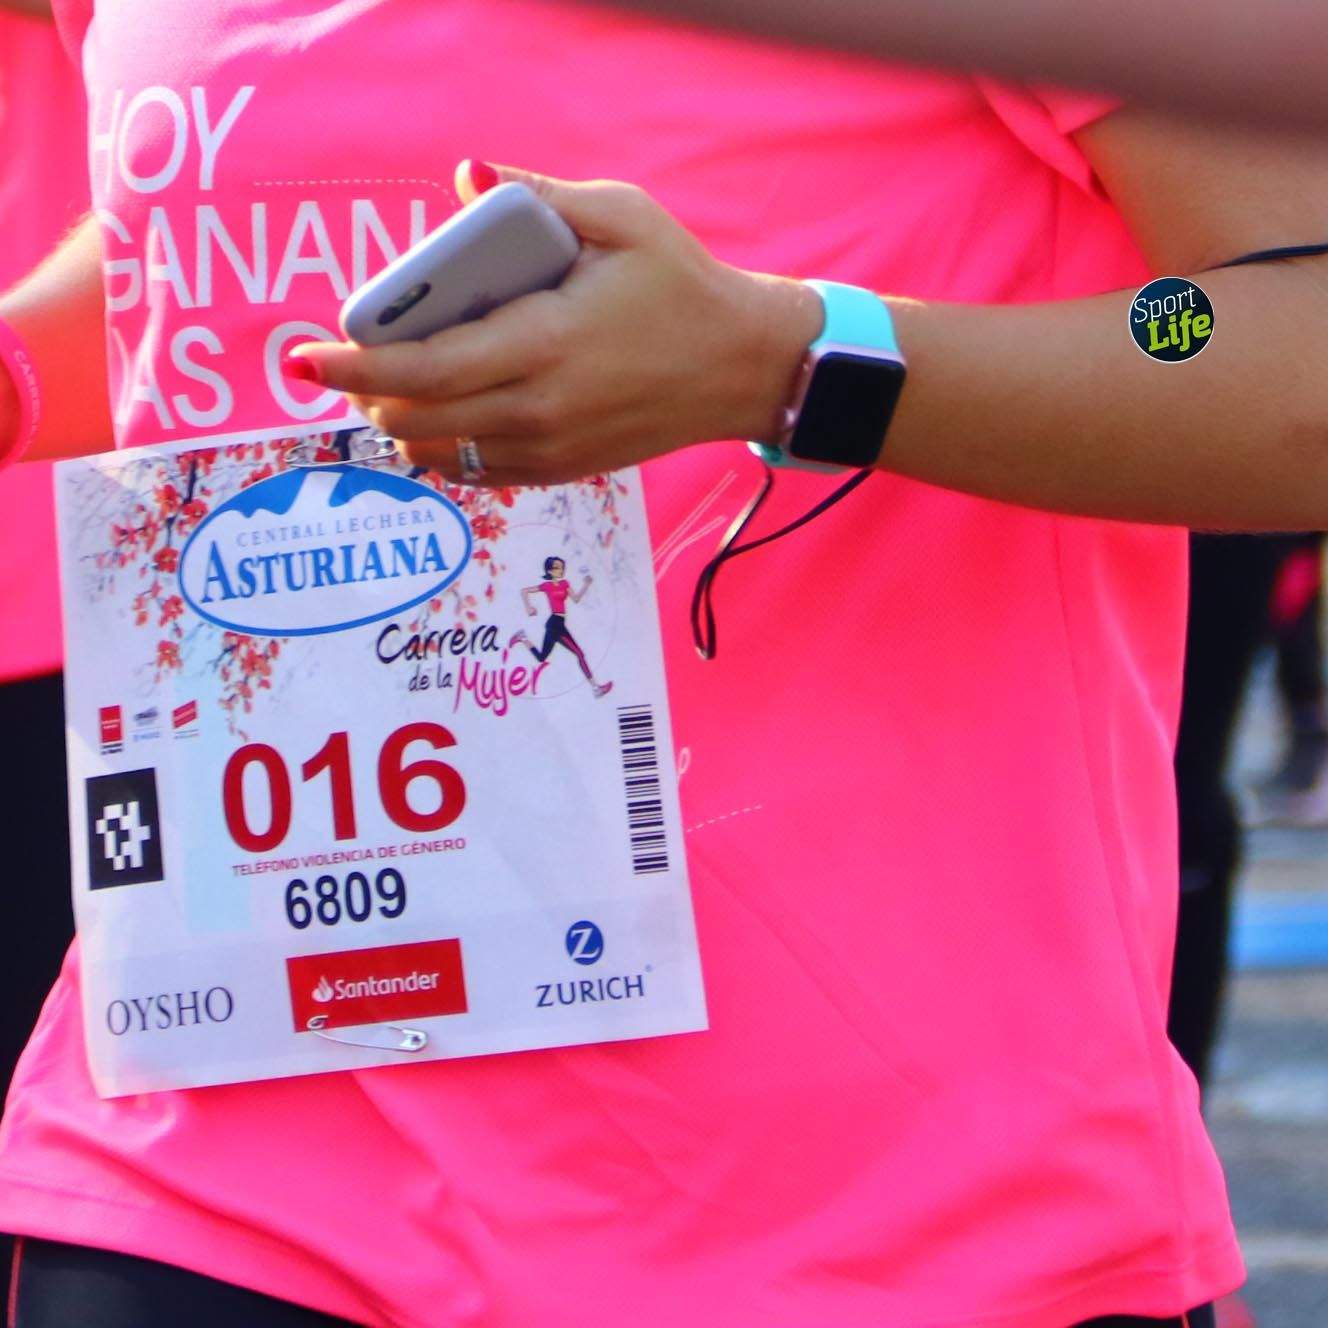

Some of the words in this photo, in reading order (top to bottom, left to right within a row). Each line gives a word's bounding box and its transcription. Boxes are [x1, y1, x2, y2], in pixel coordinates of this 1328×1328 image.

[88, 84, 256, 195] HOY
[112, 318, 235, 430] AS
[236, 524, 326, 548] CENTRAL
[335, 508, 437, 535] LECHERA
[200, 532, 450, 604] ASTURIANA
[376, 623, 500, 665] Carrera
[408, 662, 431, 692] de
[436, 660, 453, 689] la
[452, 647, 550, 717] Mujer
[222, 721, 468, 854] 016
[302, 848, 375, 869] VIOLENCIA
[377, 845, 399, 859] DE
[284, 867, 408, 930] 6809
[106, 985, 235, 1036] OYSHO
[334, 971, 440, 1001] Santander
[535, 974, 645, 1008] ZURICH
